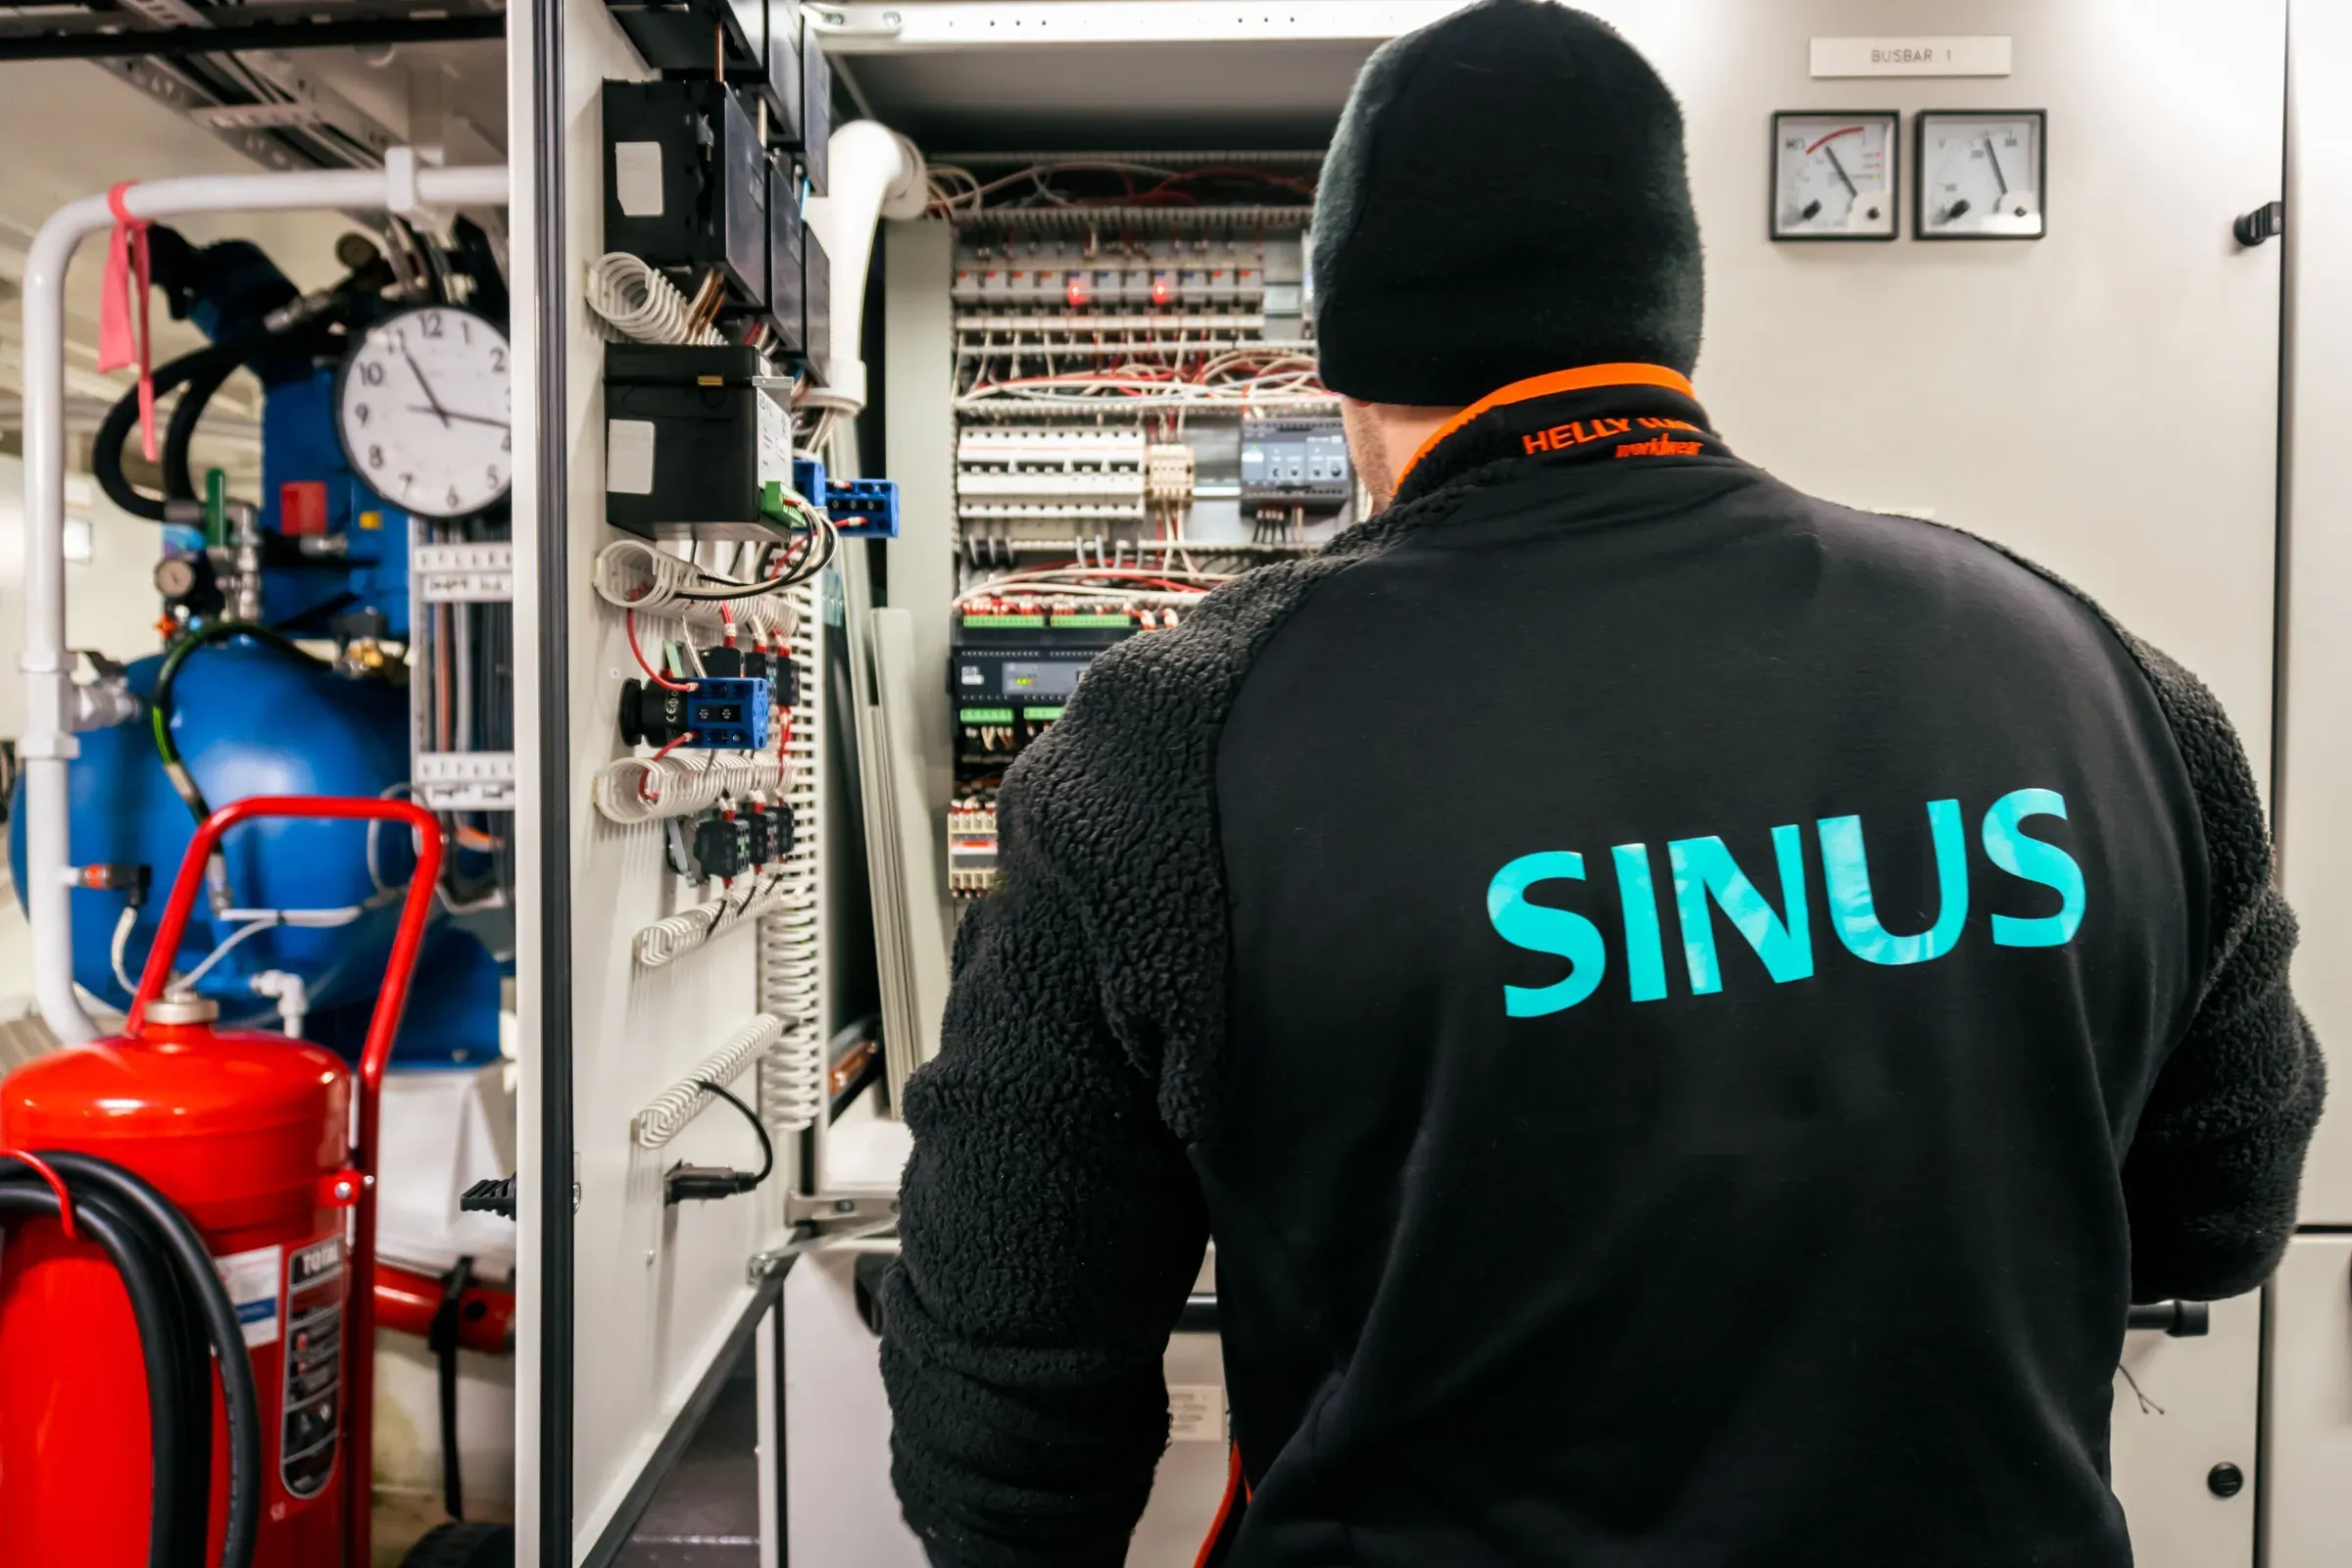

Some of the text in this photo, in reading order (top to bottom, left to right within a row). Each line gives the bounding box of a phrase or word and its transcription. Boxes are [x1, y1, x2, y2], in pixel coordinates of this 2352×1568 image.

[1871, 49, 1952, 63] BUSBAR 1
[418, 313, 444, 338] 12
[461, 319, 472, 345] 1
[490, 347, 506, 372] 2
[357, 362, 384, 386] 10
[355, 402, 369, 428] 9
[1522, 417, 1632, 455] HELLY
[368, 445, 384, 470] 8
[398, 472, 414, 499] 7
[487, 464, 499, 489] 5
[446, 484, 460, 509] 6
[1487, 788, 2085, 1018] SINUS
